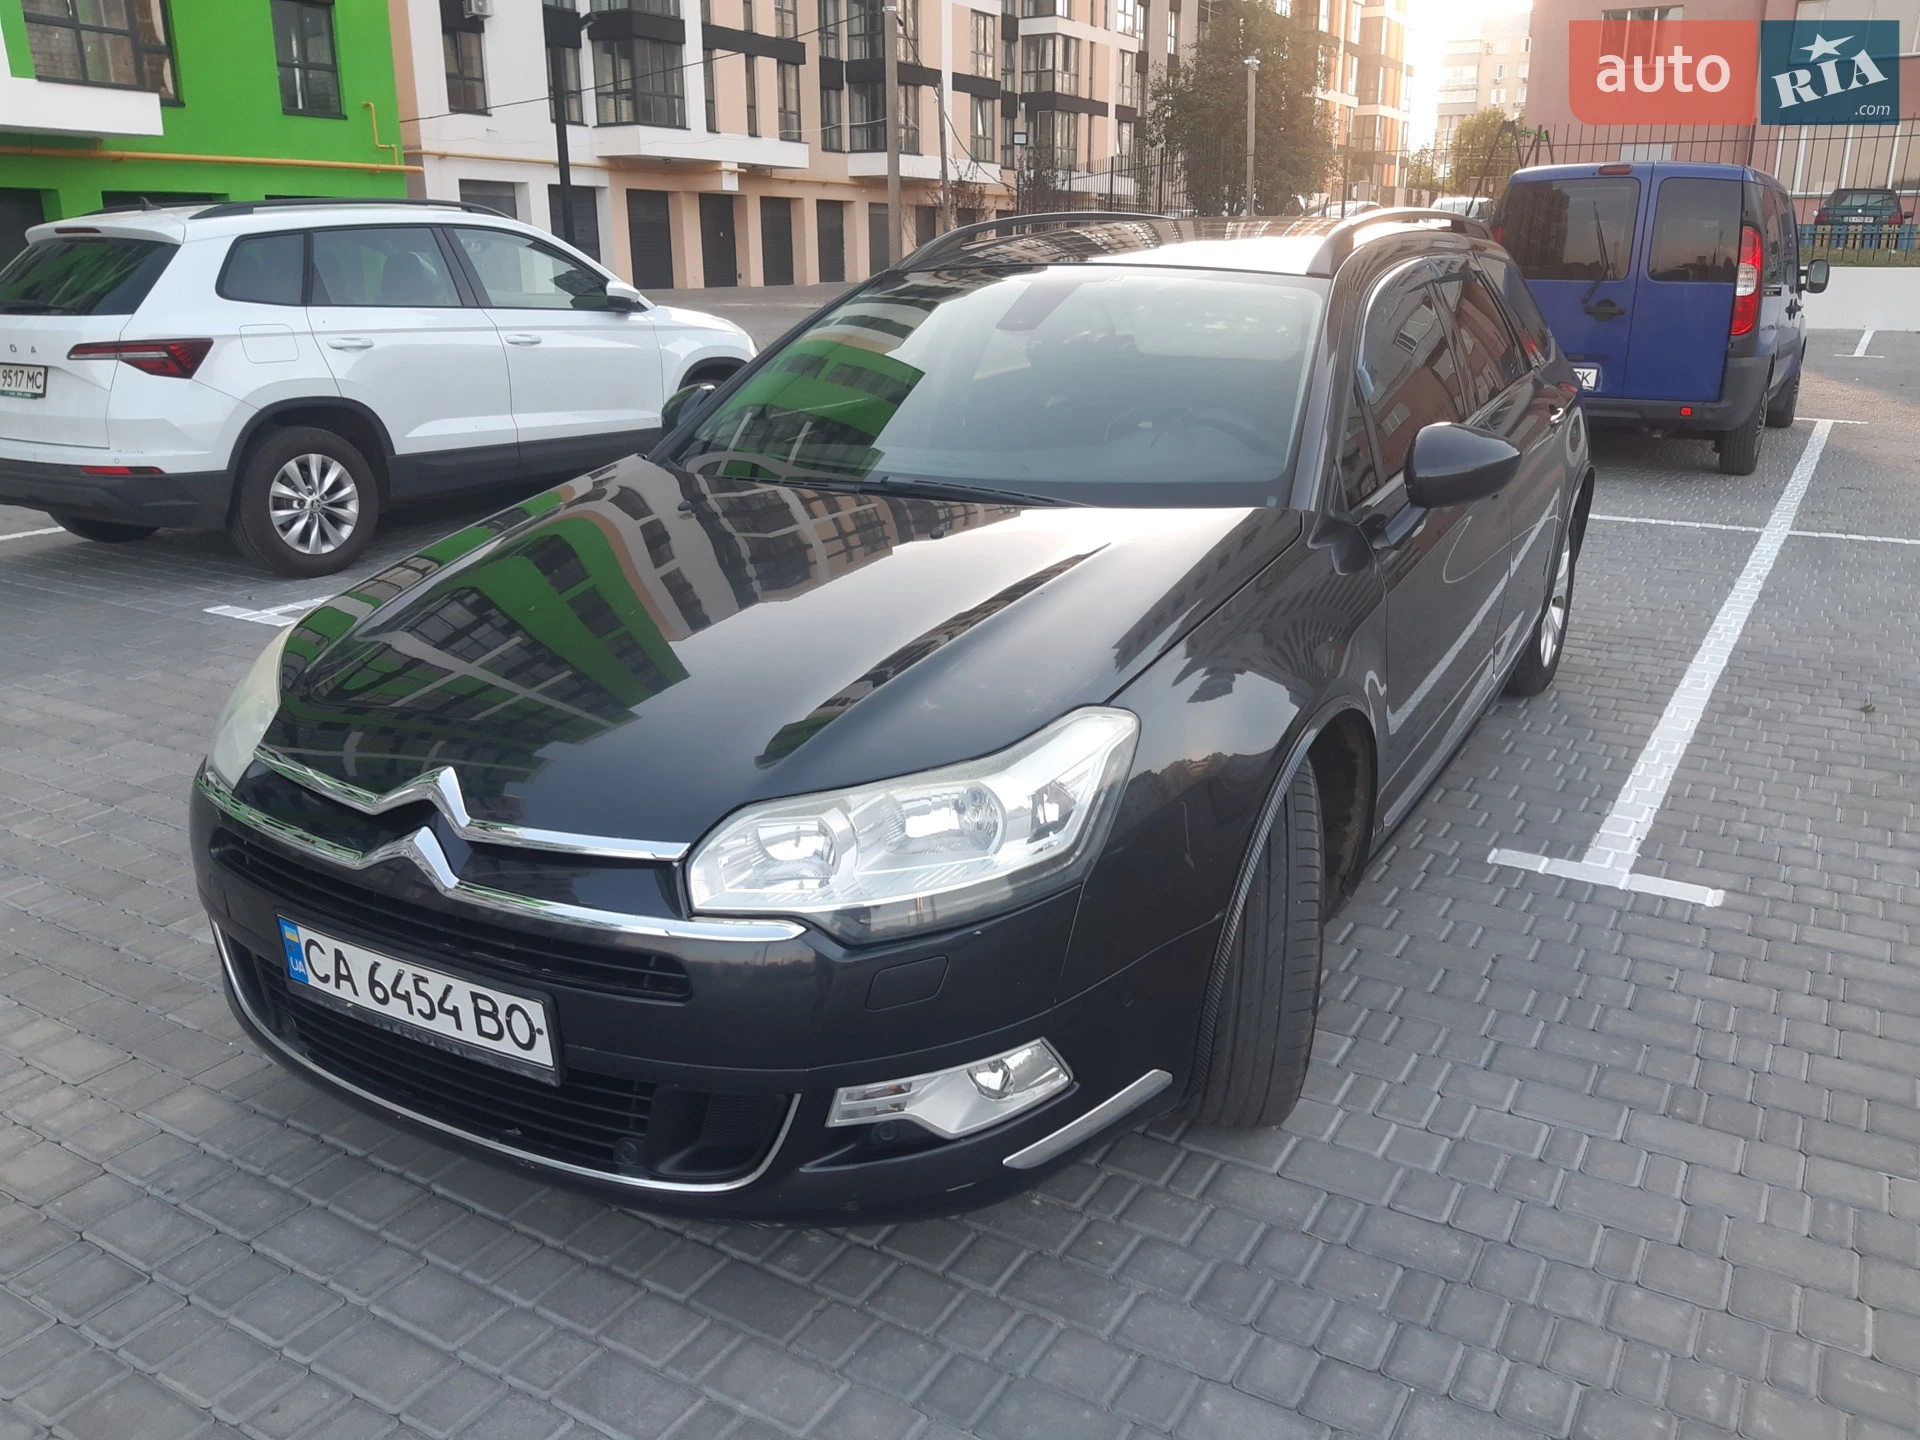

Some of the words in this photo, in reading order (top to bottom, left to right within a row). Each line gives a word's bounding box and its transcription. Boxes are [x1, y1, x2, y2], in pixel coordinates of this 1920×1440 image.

[2, 368, 25, 389] 9517
[25, 370, 43, 390] MC
[289, 955, 308, 975] UA
[304, 938, 360, 998] CA
[367, 960, 463, 1032] 6454
[469, 990, 537, 1052] BO
